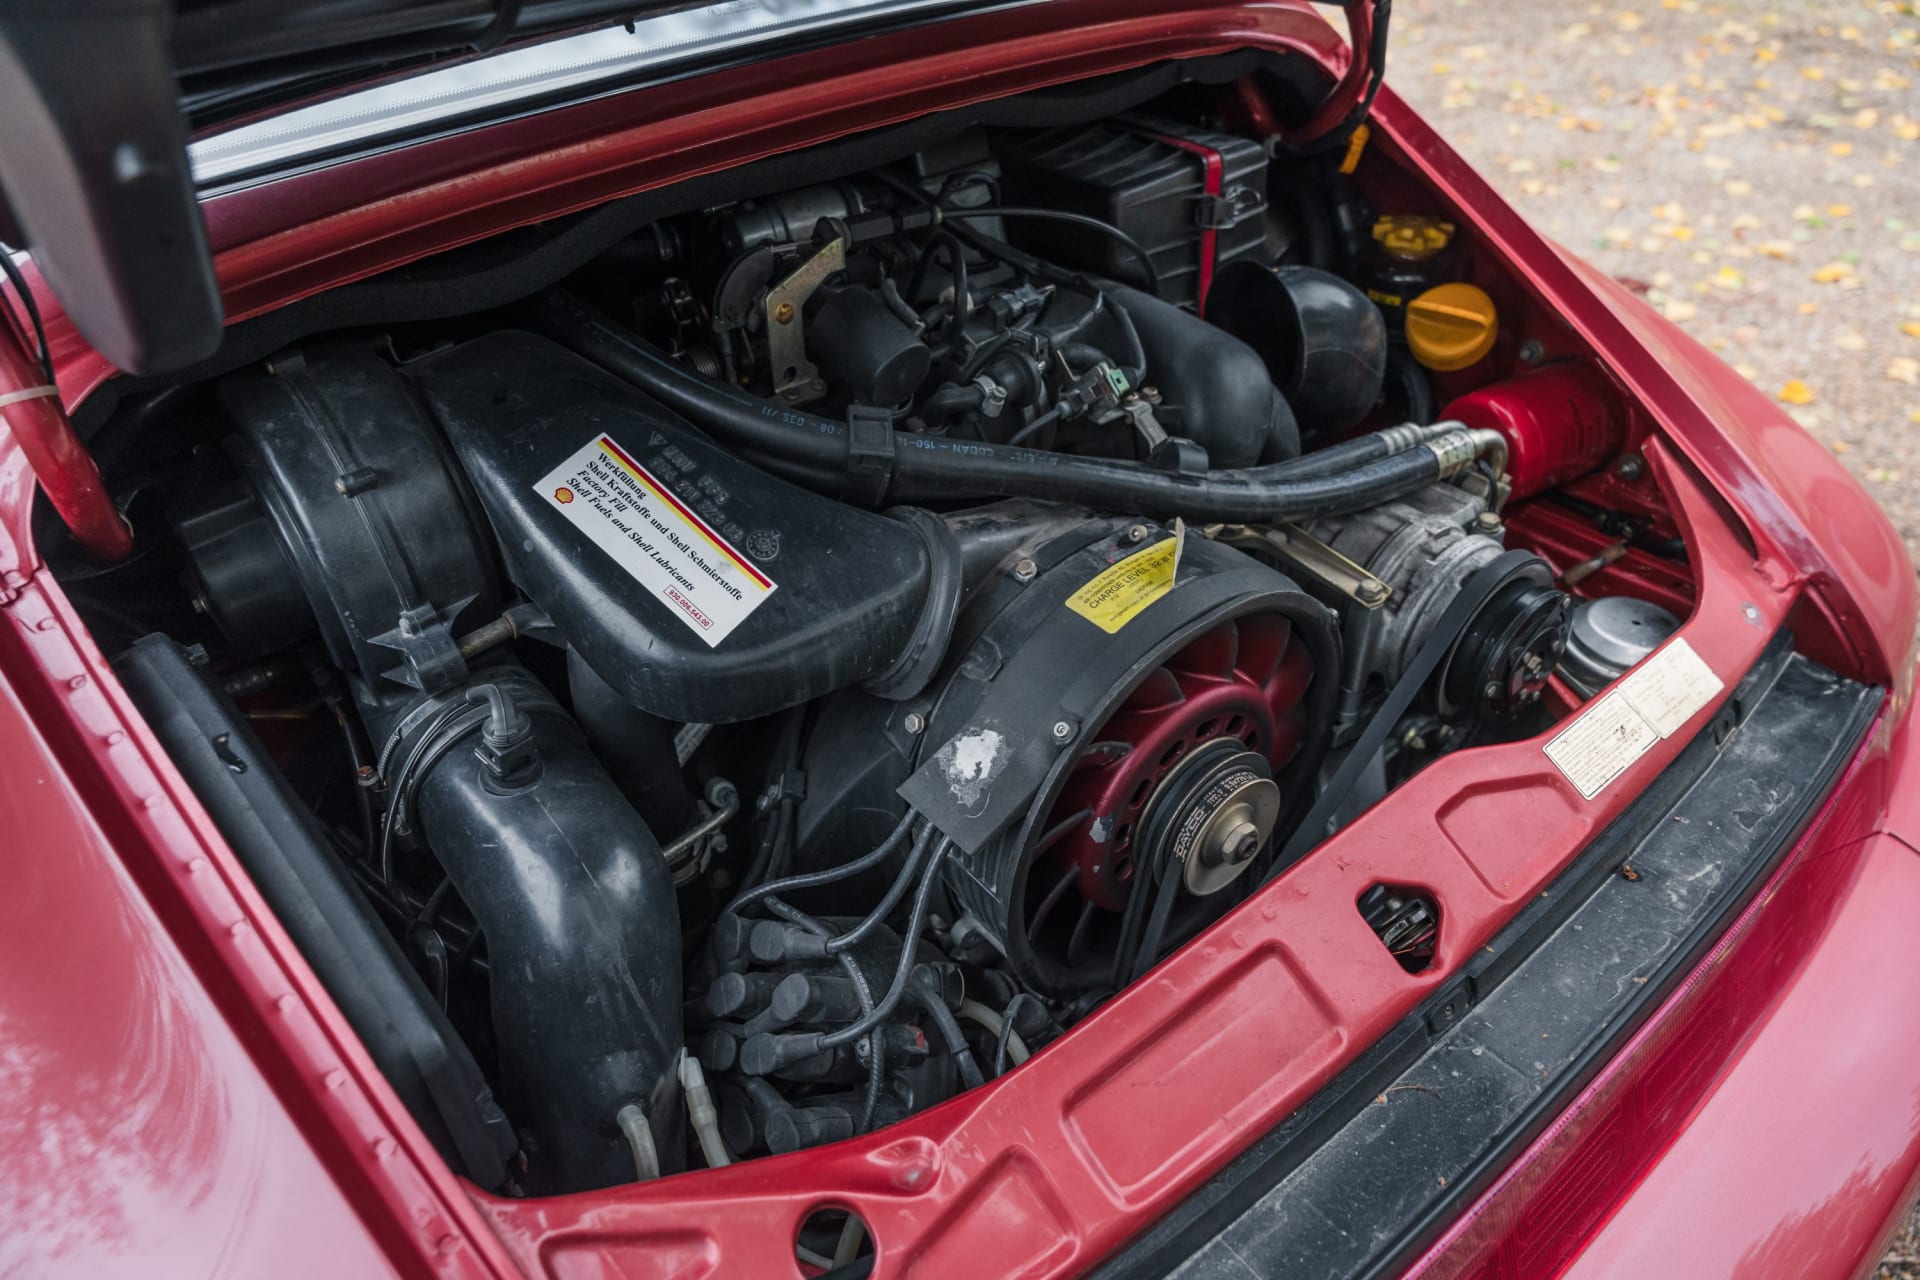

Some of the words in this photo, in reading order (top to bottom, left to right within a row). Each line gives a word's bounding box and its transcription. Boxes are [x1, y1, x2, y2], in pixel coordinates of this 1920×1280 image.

[577, 469, 611, 499] Factory
[608, 494, 629, 514] Fill
[598, 452, 647, 500] Werkfüllung
[566, 477, 590, 499] Shell
[589, 495, 614, 520] Fuels
[611, 516, 631, 535] and
[628, 531, 655, 554] Shell
[650, 550, 697, 593] Lubricants
[586, 460, 608, 482] Shell
[606, 477, 652, 520] Kraftstoffe
[650, 517, 670, 536] und
[666, 532, 691, 554] Shell
[687, 550, 744, 602] Schmierstoffe
[1089, 580, 1125, 609] CHARGE
[1122, 565, 1150, 584] LEVEL
